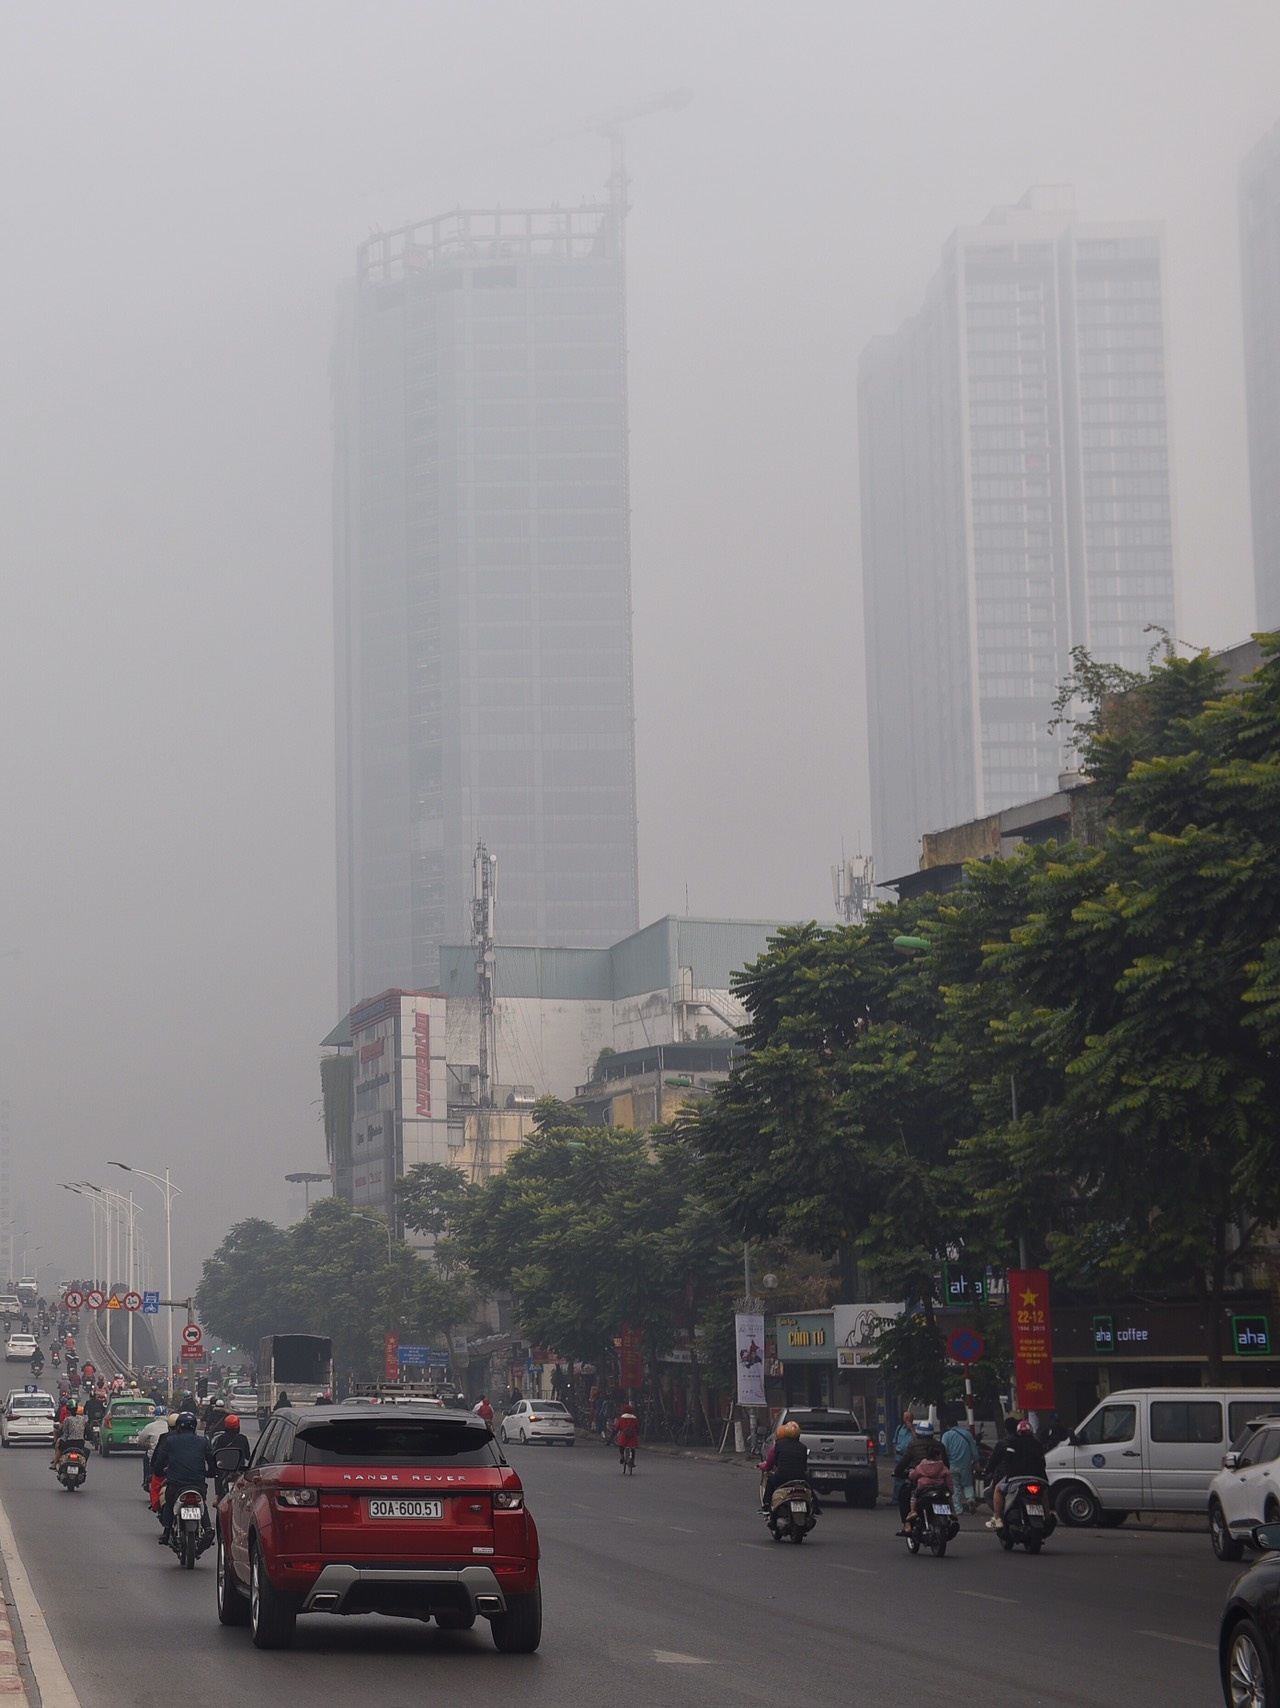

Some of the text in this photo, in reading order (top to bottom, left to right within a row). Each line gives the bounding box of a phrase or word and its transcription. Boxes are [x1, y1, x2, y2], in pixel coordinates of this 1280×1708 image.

[1017, 1310, 1045, 1323] 22-12
[1095, 1326, 1148, 1342] aha coffee
[1238, 1327, 1267, 1345] aha
[371, 1502, 439, 1516] 30A-600.51
